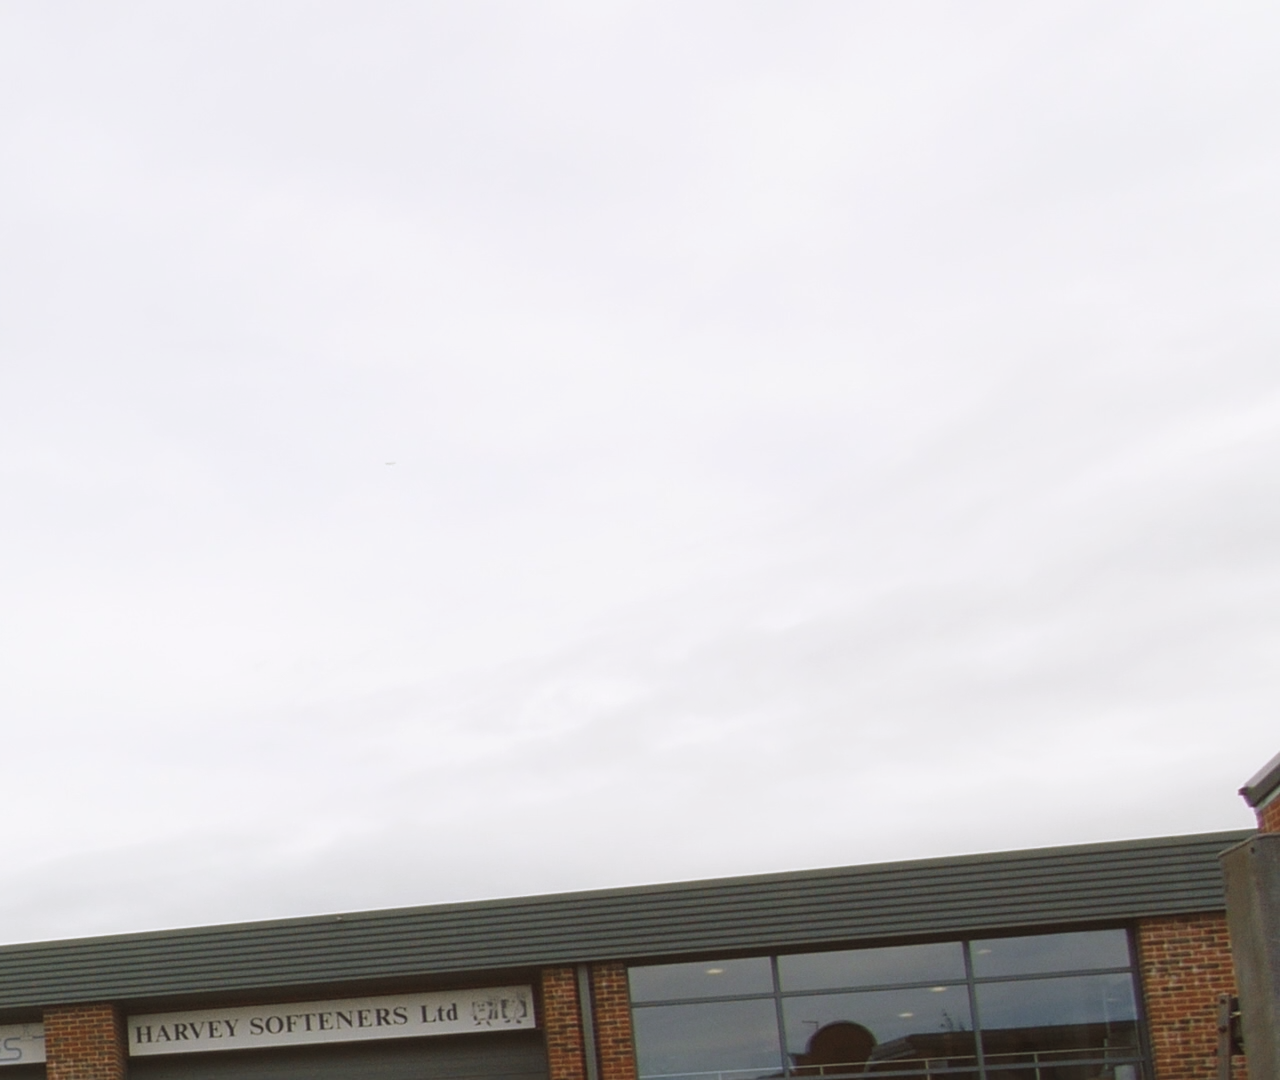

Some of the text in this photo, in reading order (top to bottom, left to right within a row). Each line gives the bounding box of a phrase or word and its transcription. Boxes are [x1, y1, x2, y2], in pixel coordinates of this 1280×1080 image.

[135, 1003, 459, 1045] HARVEY SOFTENERS Ltd
